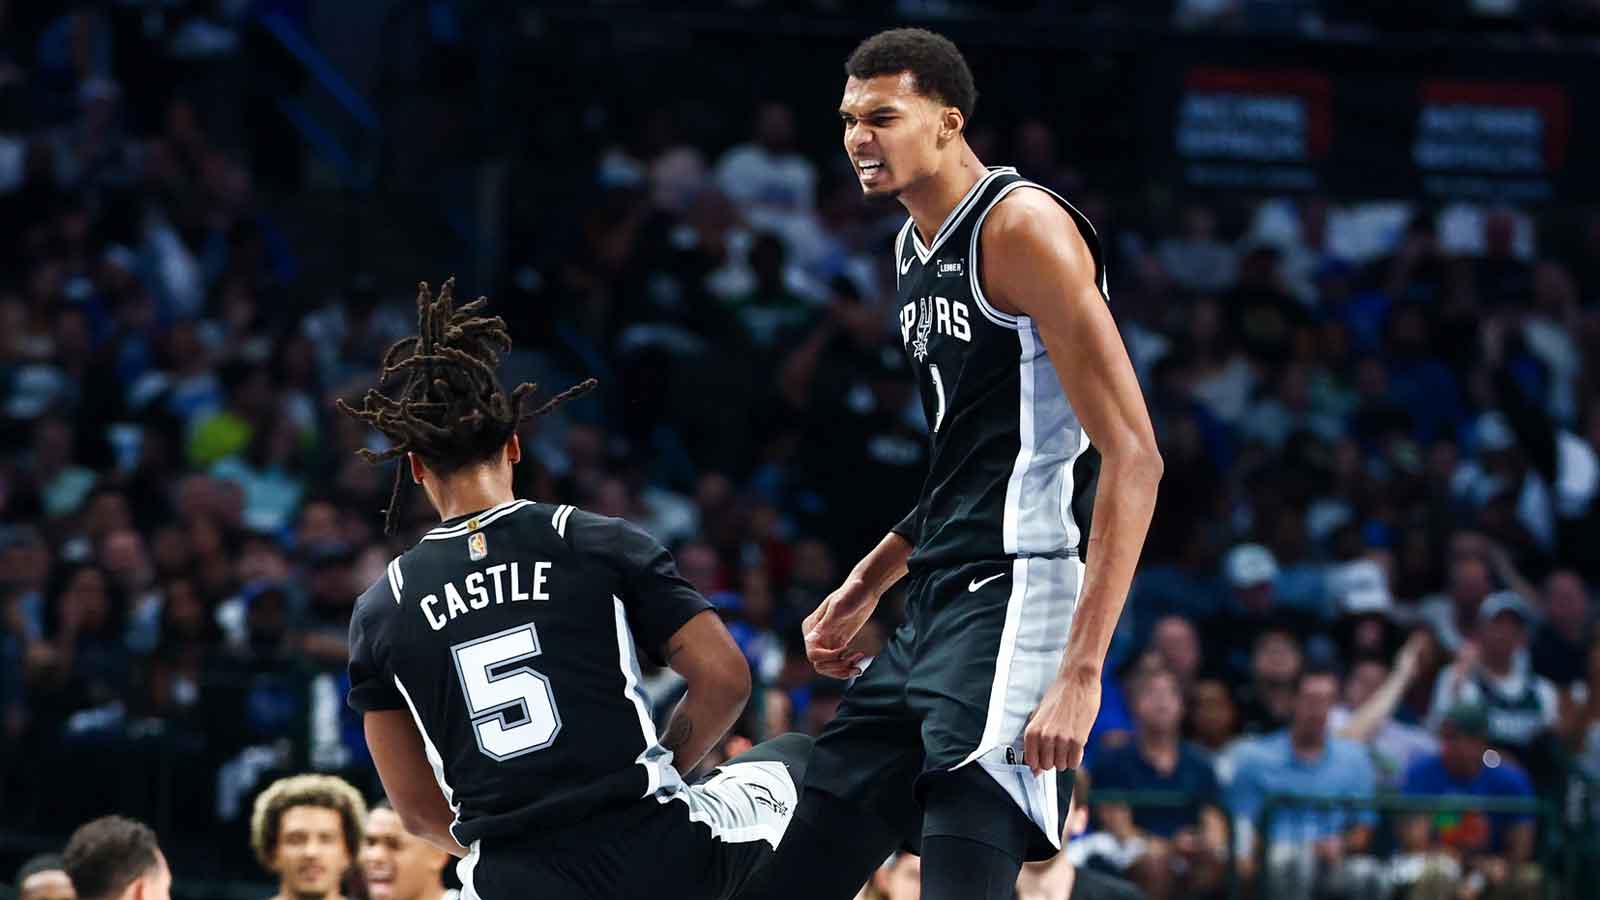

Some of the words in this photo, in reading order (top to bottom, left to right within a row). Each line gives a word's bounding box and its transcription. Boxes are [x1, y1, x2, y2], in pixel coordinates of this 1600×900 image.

[900, 296, 971, 362] PURS
[929, 363, 946, 433] 1
[420, 561, 552, 631] CASTLE
[450, 622, 562, 762] 5
